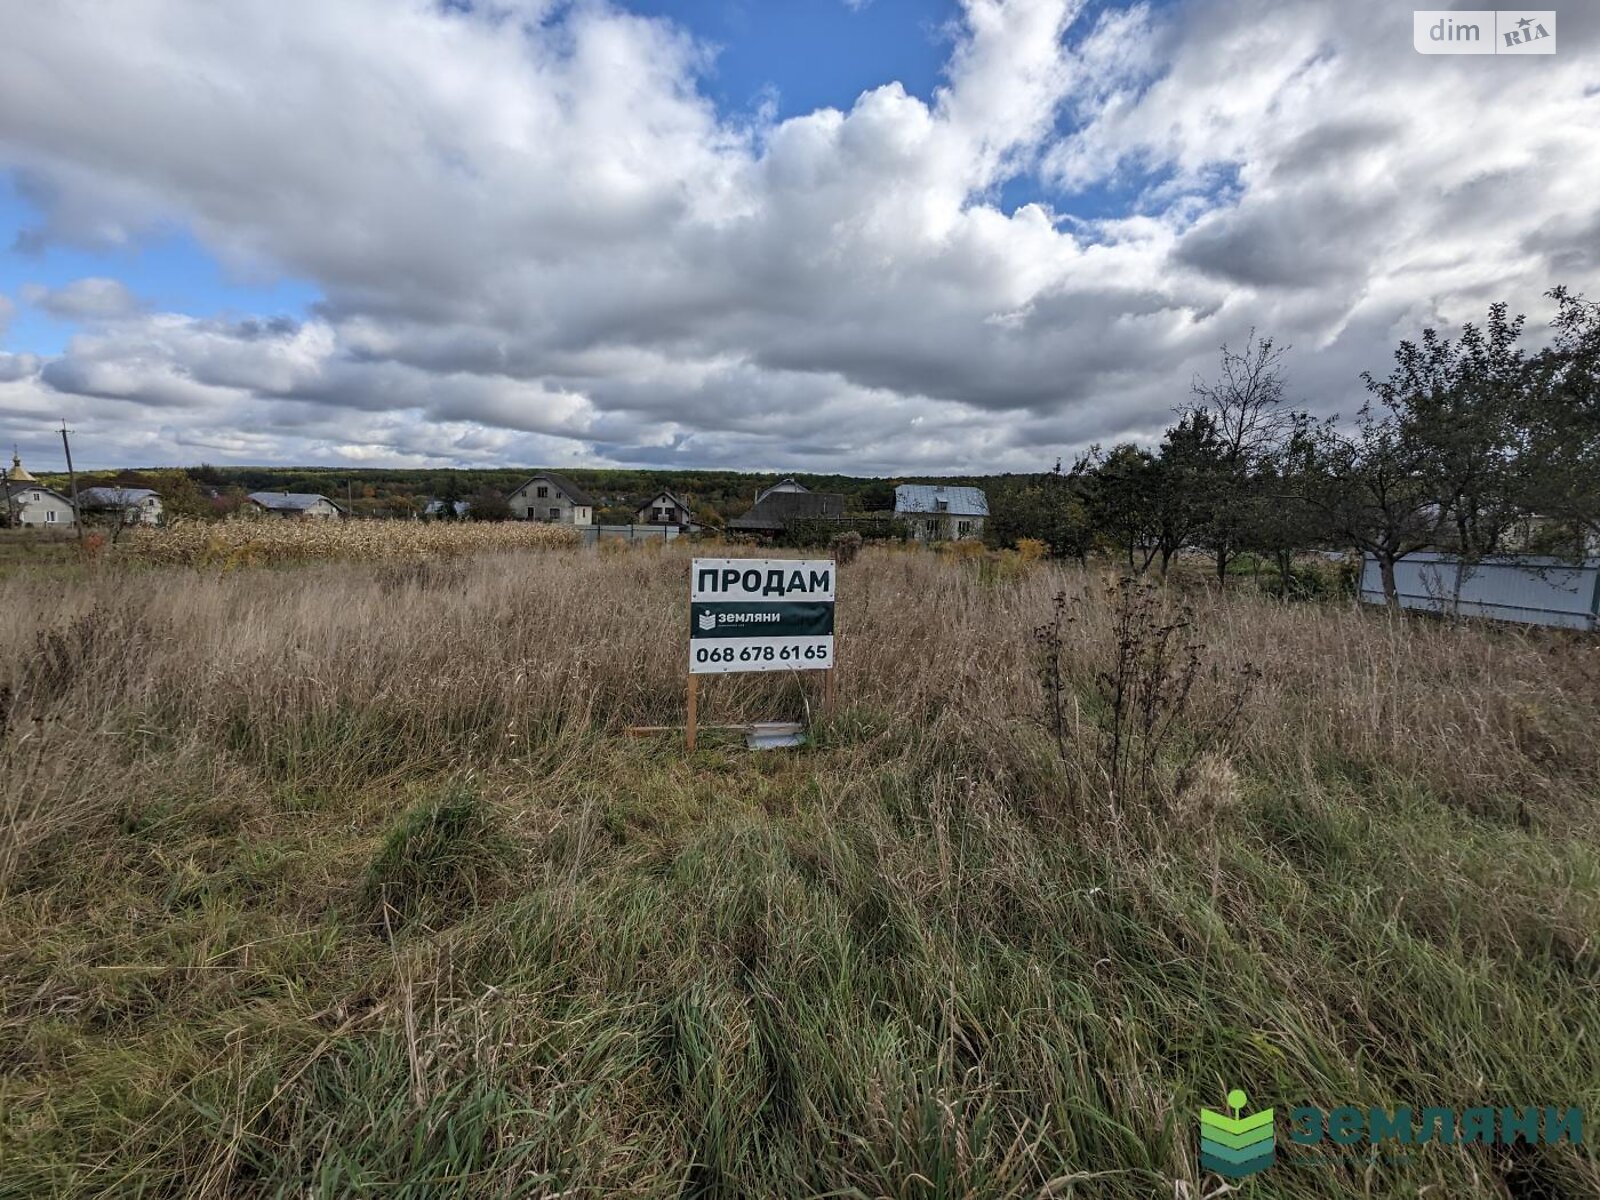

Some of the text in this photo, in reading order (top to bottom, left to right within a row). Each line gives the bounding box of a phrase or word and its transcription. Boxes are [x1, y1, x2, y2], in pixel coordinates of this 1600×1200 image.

[697, 568, 830, 597] ПРОДАМ
[718, 612, 780, 623] земляни
[696, 645, 827, 663] 068 678 61 65
